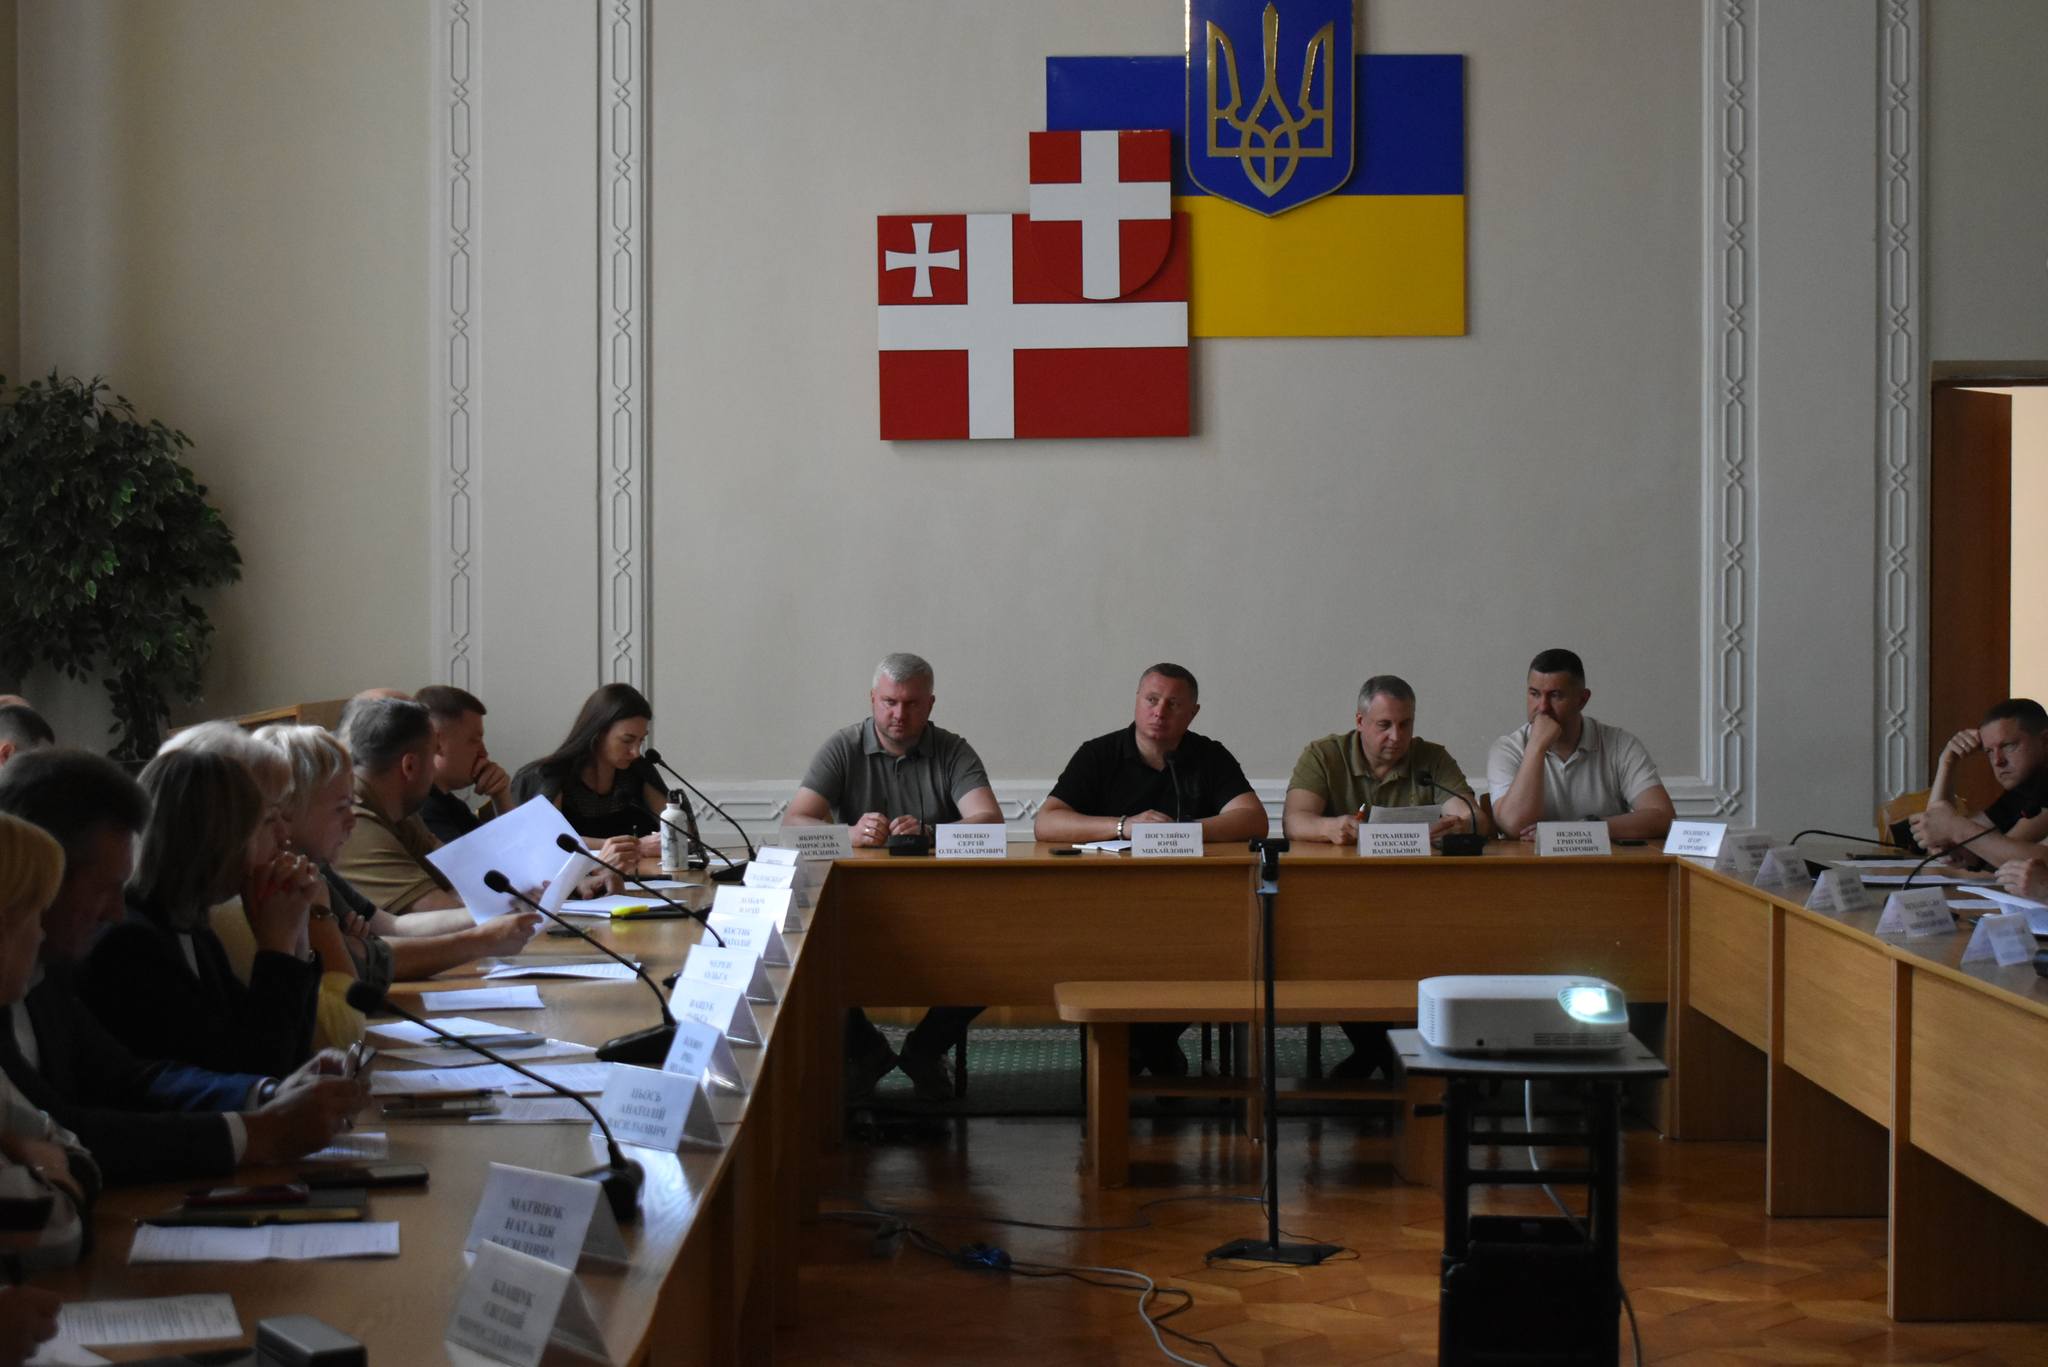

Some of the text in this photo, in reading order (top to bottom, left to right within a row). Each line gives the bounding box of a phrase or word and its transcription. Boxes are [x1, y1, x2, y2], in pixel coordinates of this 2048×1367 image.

[1144, 831, 1190, 839] ПОГУЛЯЙКО
[957, 839, 985, 847] СЕРГІЙ
[1157, 839, 1178, 847] ЮРІЙ
[799, 849, 840, 857] АСИЛІВНА
[938, 848, 1004, 856] ОЛЕКСАНДРОВИЧ
[1141, 846, 1194, 854] МИХАЙЛОВИЧ
[1372, 847, 1421, 855] ВАСИЛЬОВИЧ
[1552, 845, 1599, 853] ВІКТОРОВИЧ
[631, 1087, 662, 1103] ЦЬОСЬ
[620, 1104, 667, 1120] АНАТОЛІЙ
[504, 1217, 557, 1239] НАТАЛІЯ
